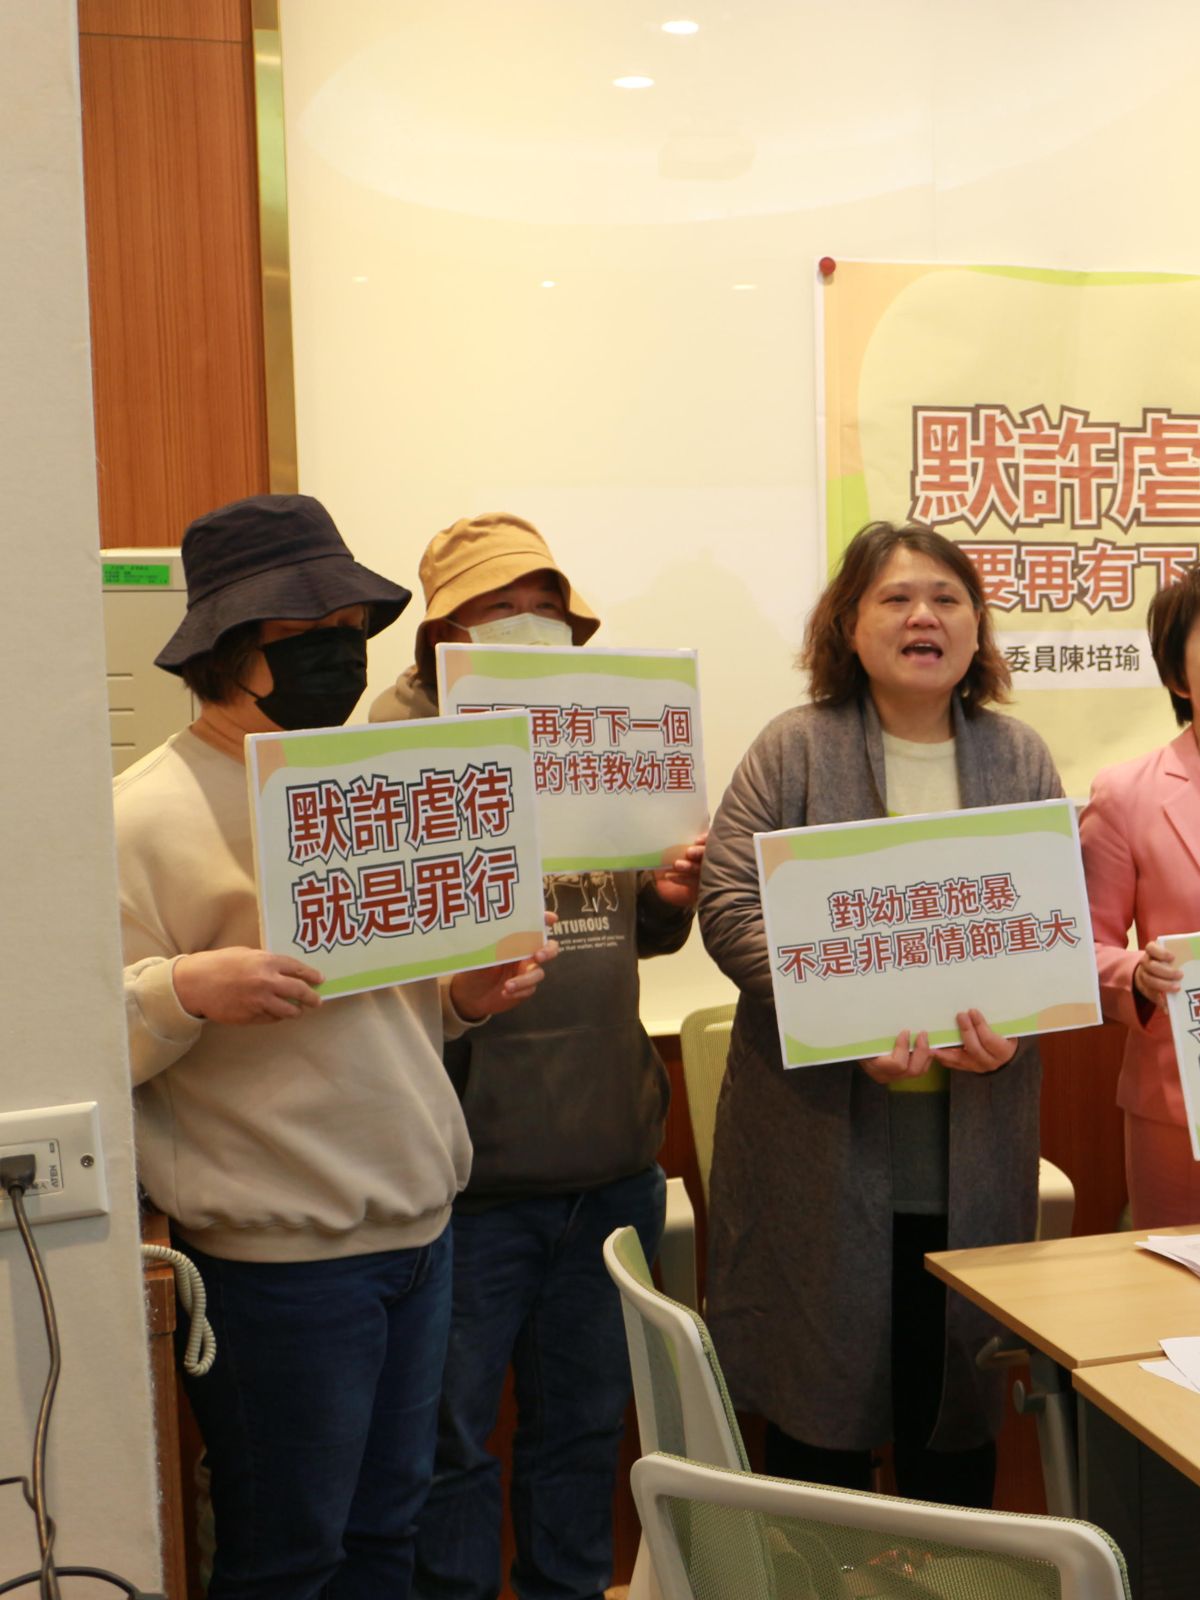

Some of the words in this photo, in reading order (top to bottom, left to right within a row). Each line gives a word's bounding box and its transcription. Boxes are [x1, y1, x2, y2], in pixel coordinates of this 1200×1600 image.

[457, 703, 693, 748] 再有下一個
[532, 750, 697, 795] 的特教幼童
[286, 761, 513, 865] 默許虐待
[292, 847, 519, 954] 就是罪行
[828, 873, 1020, 932] 對幼童施暴
[777, 910, 1081, 984] 不是非屬情節重大
